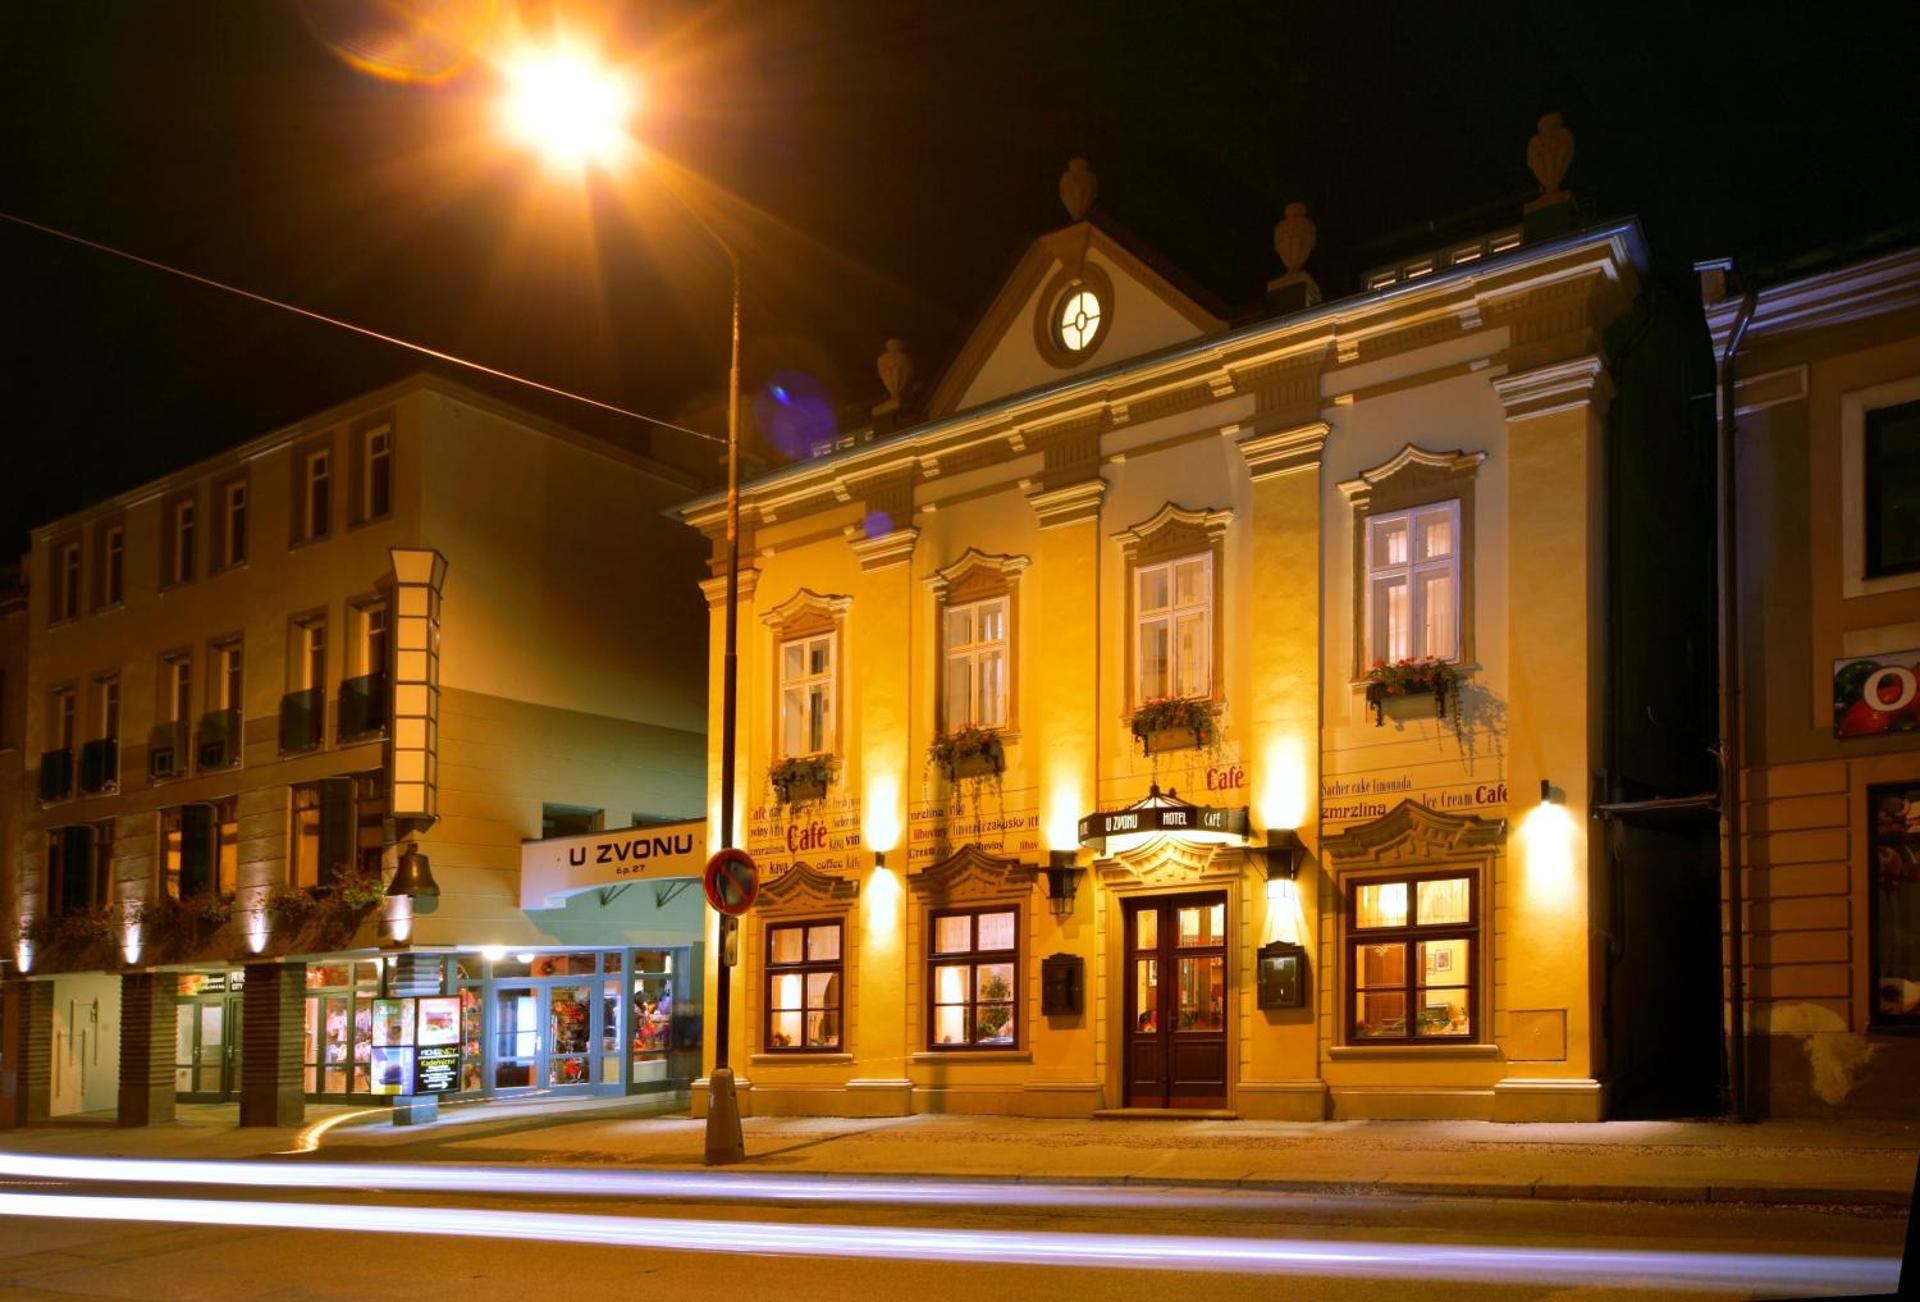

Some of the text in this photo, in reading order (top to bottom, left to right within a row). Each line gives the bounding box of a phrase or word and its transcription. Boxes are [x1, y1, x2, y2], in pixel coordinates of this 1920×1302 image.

[1207, 766, 1244, 791] Café
[1441, 790, 1472, 807] Cream
[1163, 812, 1187, 825] HOTEL
[1321, 803, 1386, 819] zmrzlina
[1105, 818, 1112, 831] U
[1113, 814, 1138, 830] ZVONU
[787, 820, 827, 852] Café
[569, 834, 692, 866] U ZVONU
